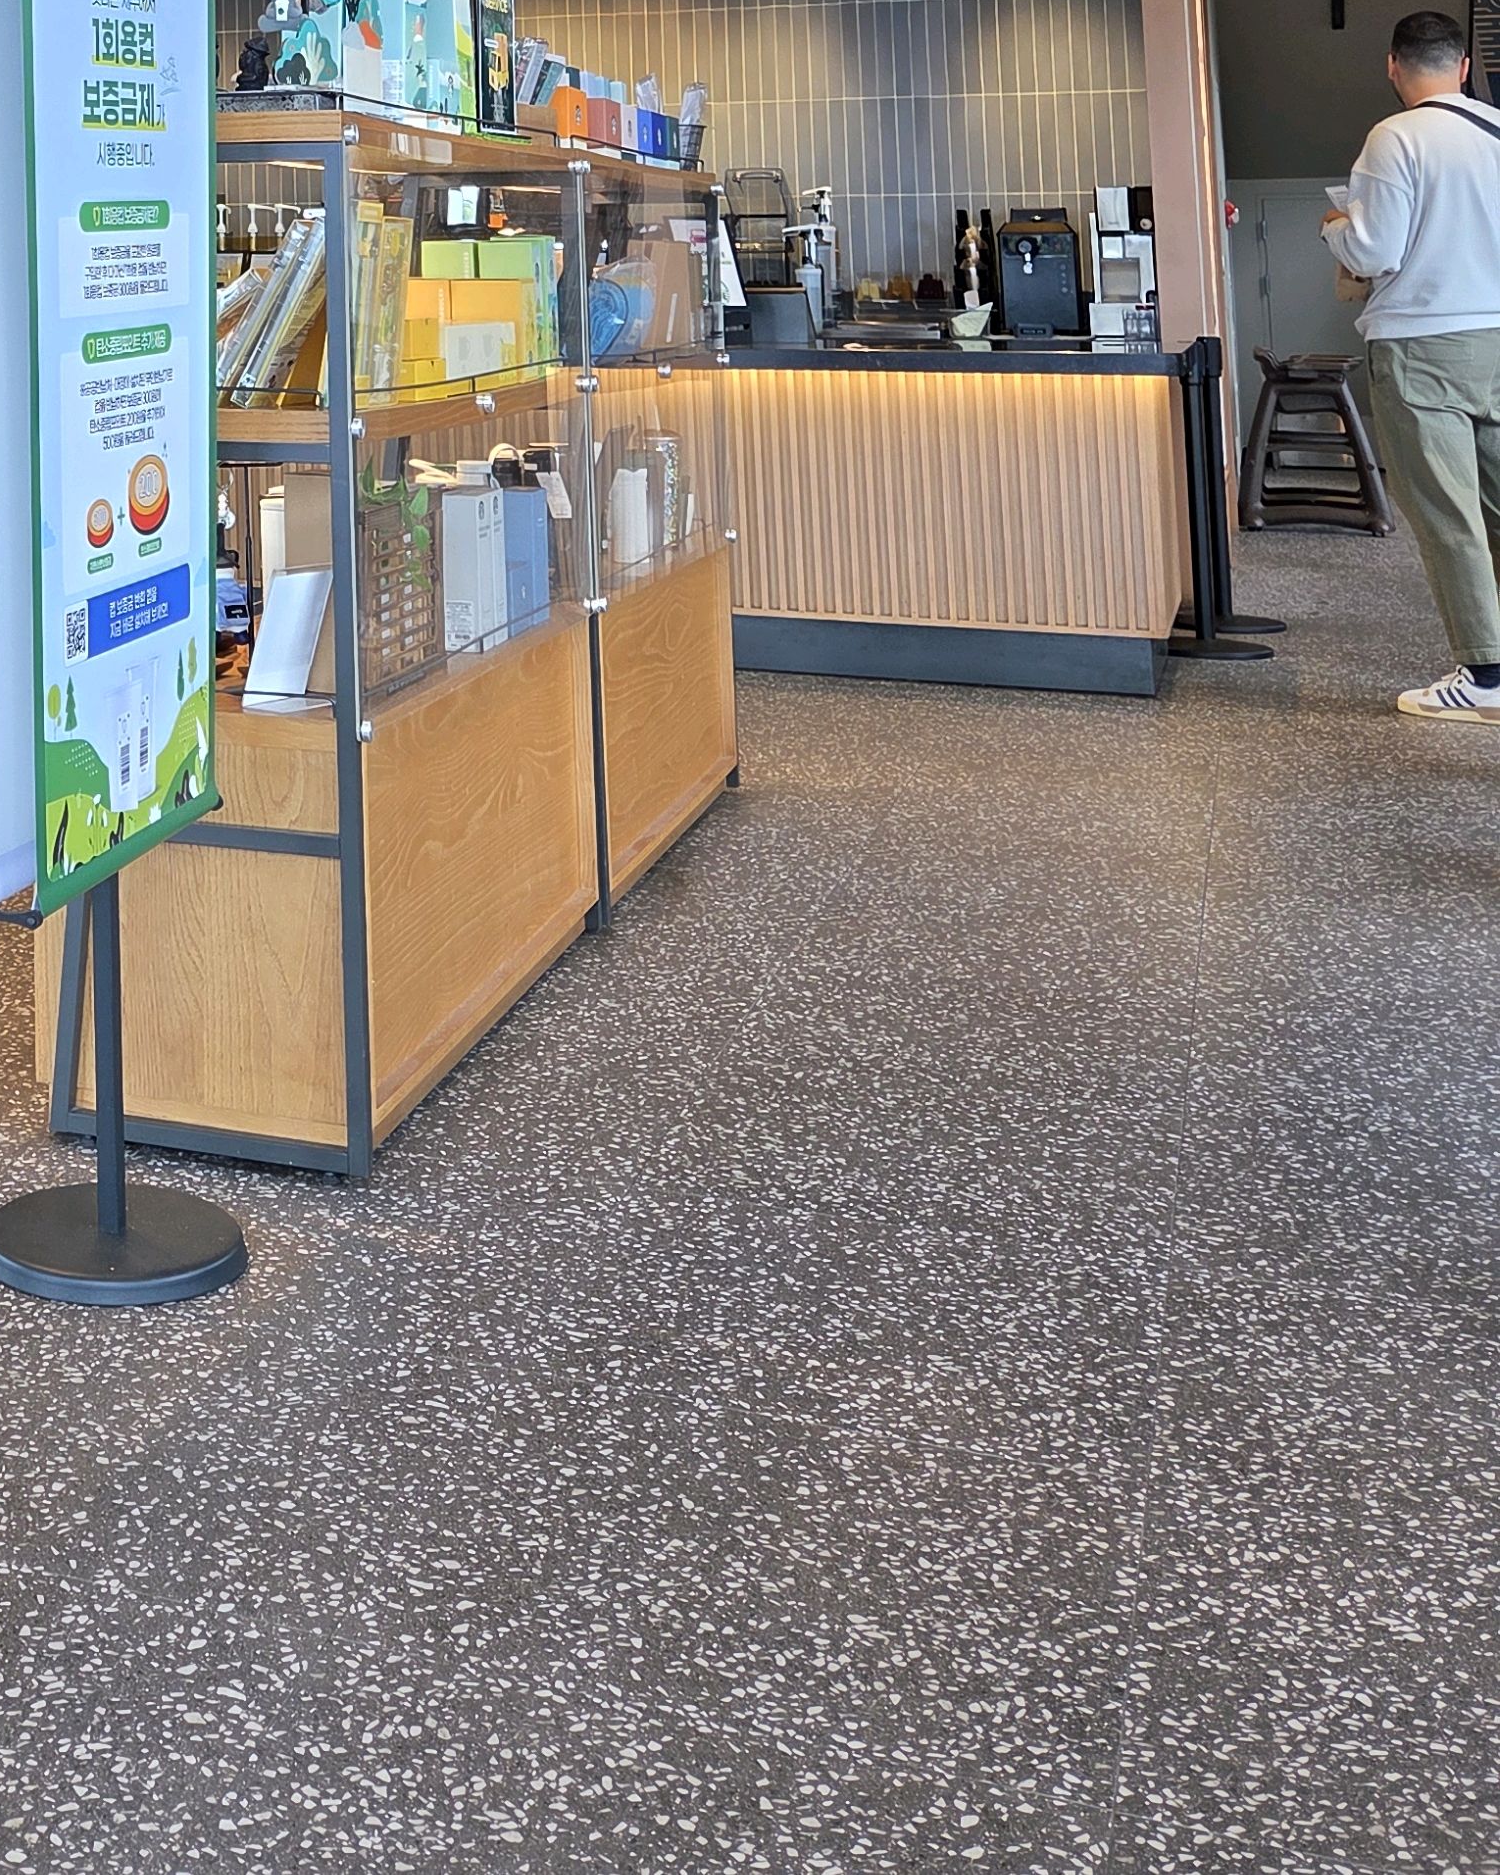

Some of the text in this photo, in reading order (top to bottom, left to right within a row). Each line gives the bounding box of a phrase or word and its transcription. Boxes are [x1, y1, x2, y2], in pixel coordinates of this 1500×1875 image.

[92, 18, 154, 67] 1회용컵
[83, 79, 165, 127] 보증금제가
[96, 142, 155, 167] 시행중입니다.
